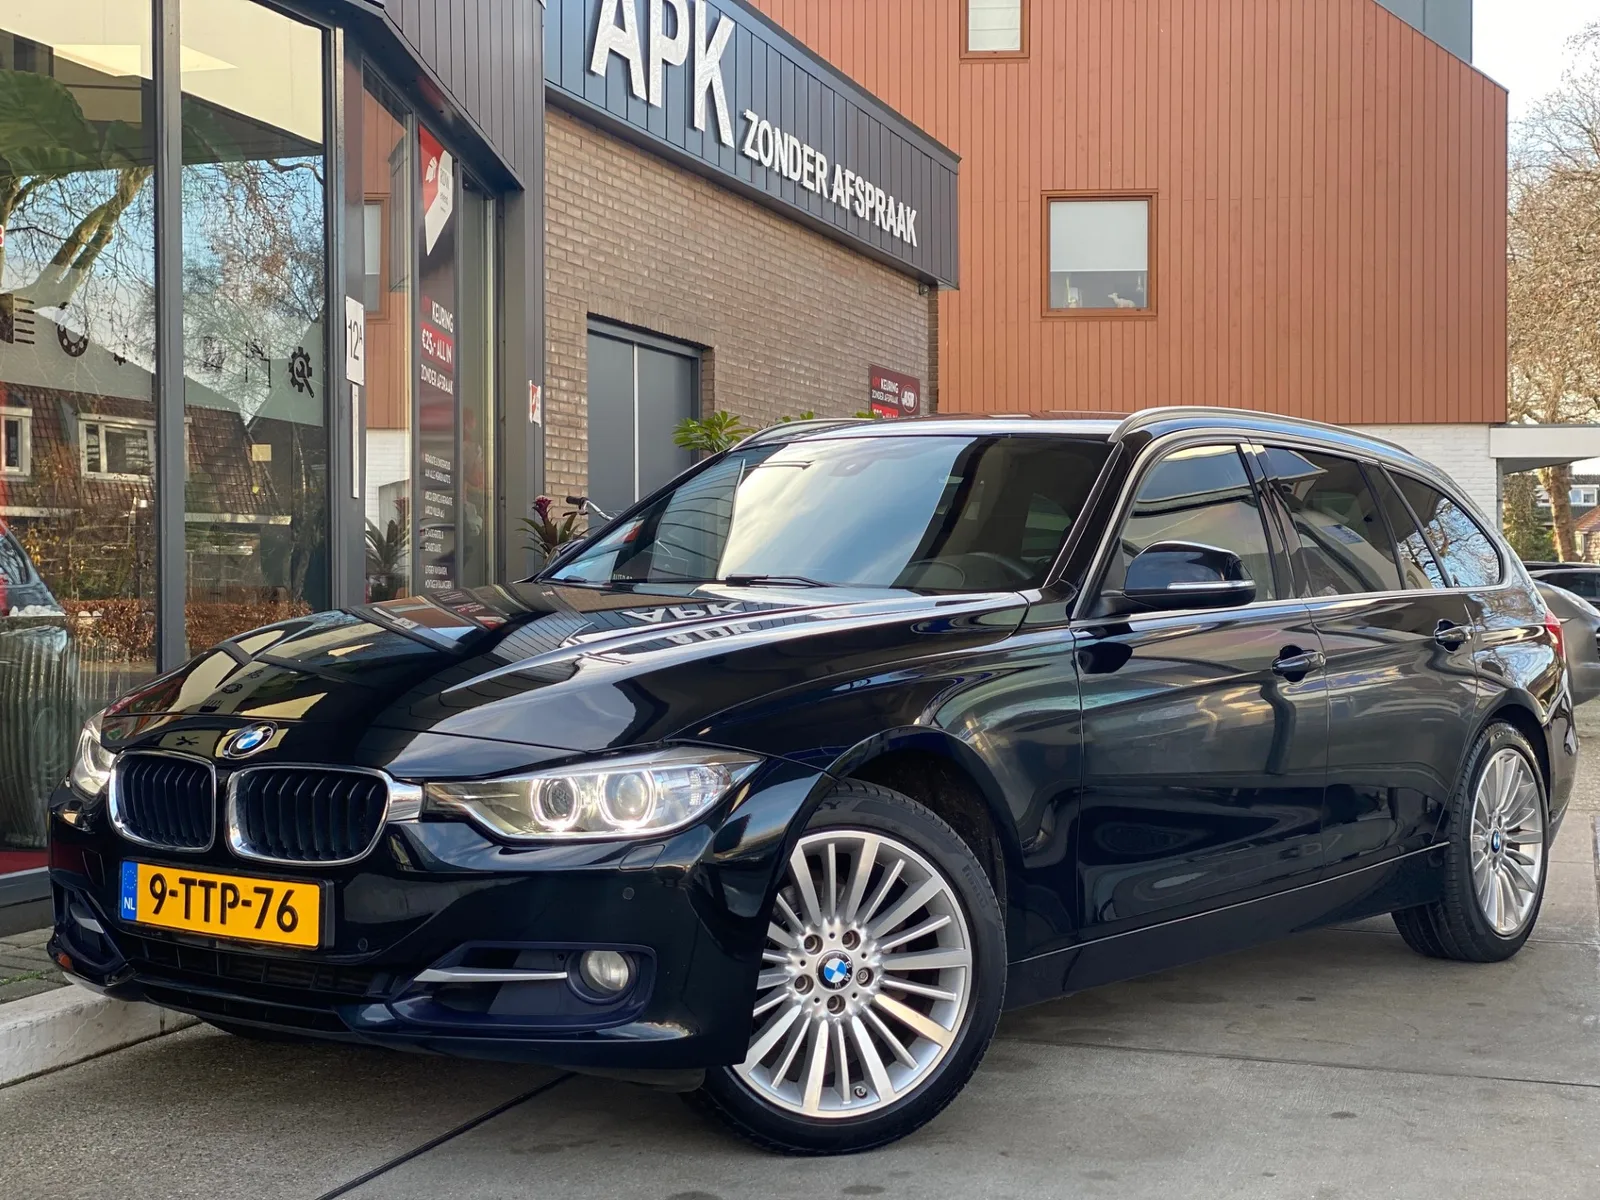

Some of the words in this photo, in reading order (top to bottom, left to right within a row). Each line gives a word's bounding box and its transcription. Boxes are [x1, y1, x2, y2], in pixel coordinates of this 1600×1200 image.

[590, 0, 735, 148] APK
[741, 108, 828, 200] ZONDER
[832, 162, 918, 248] AFSPRAAK
[123, 896, 136, 911] NL
[149, 873, 299, 933] 9-TTP-76
